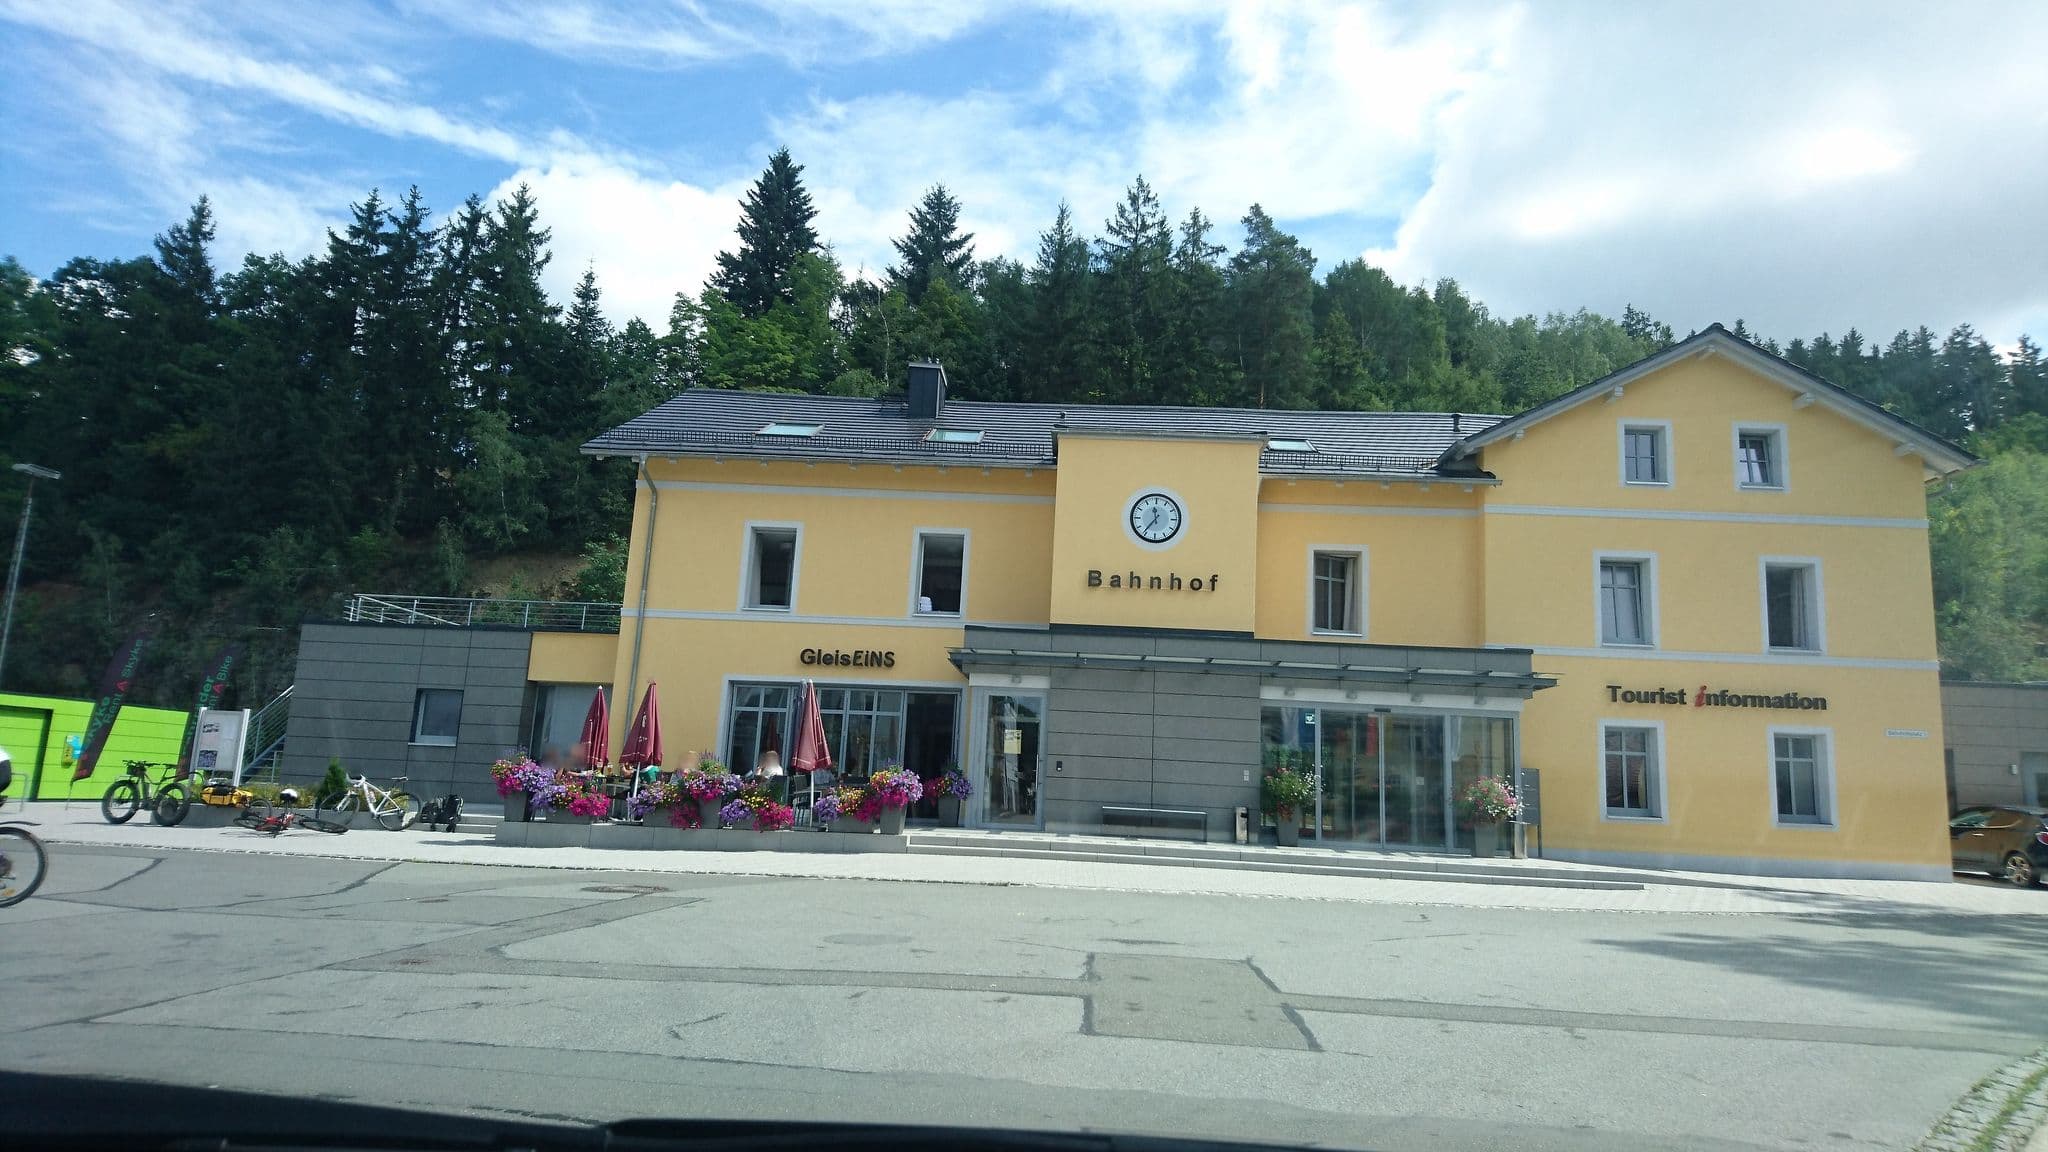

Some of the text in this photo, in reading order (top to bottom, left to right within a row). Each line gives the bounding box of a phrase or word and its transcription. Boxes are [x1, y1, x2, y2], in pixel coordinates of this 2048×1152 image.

[1088, 569, 1218, 591] Bahnhof
[216, 655, 232, 681] Bike
[1606, 685, 1828, 710] Tourist information
